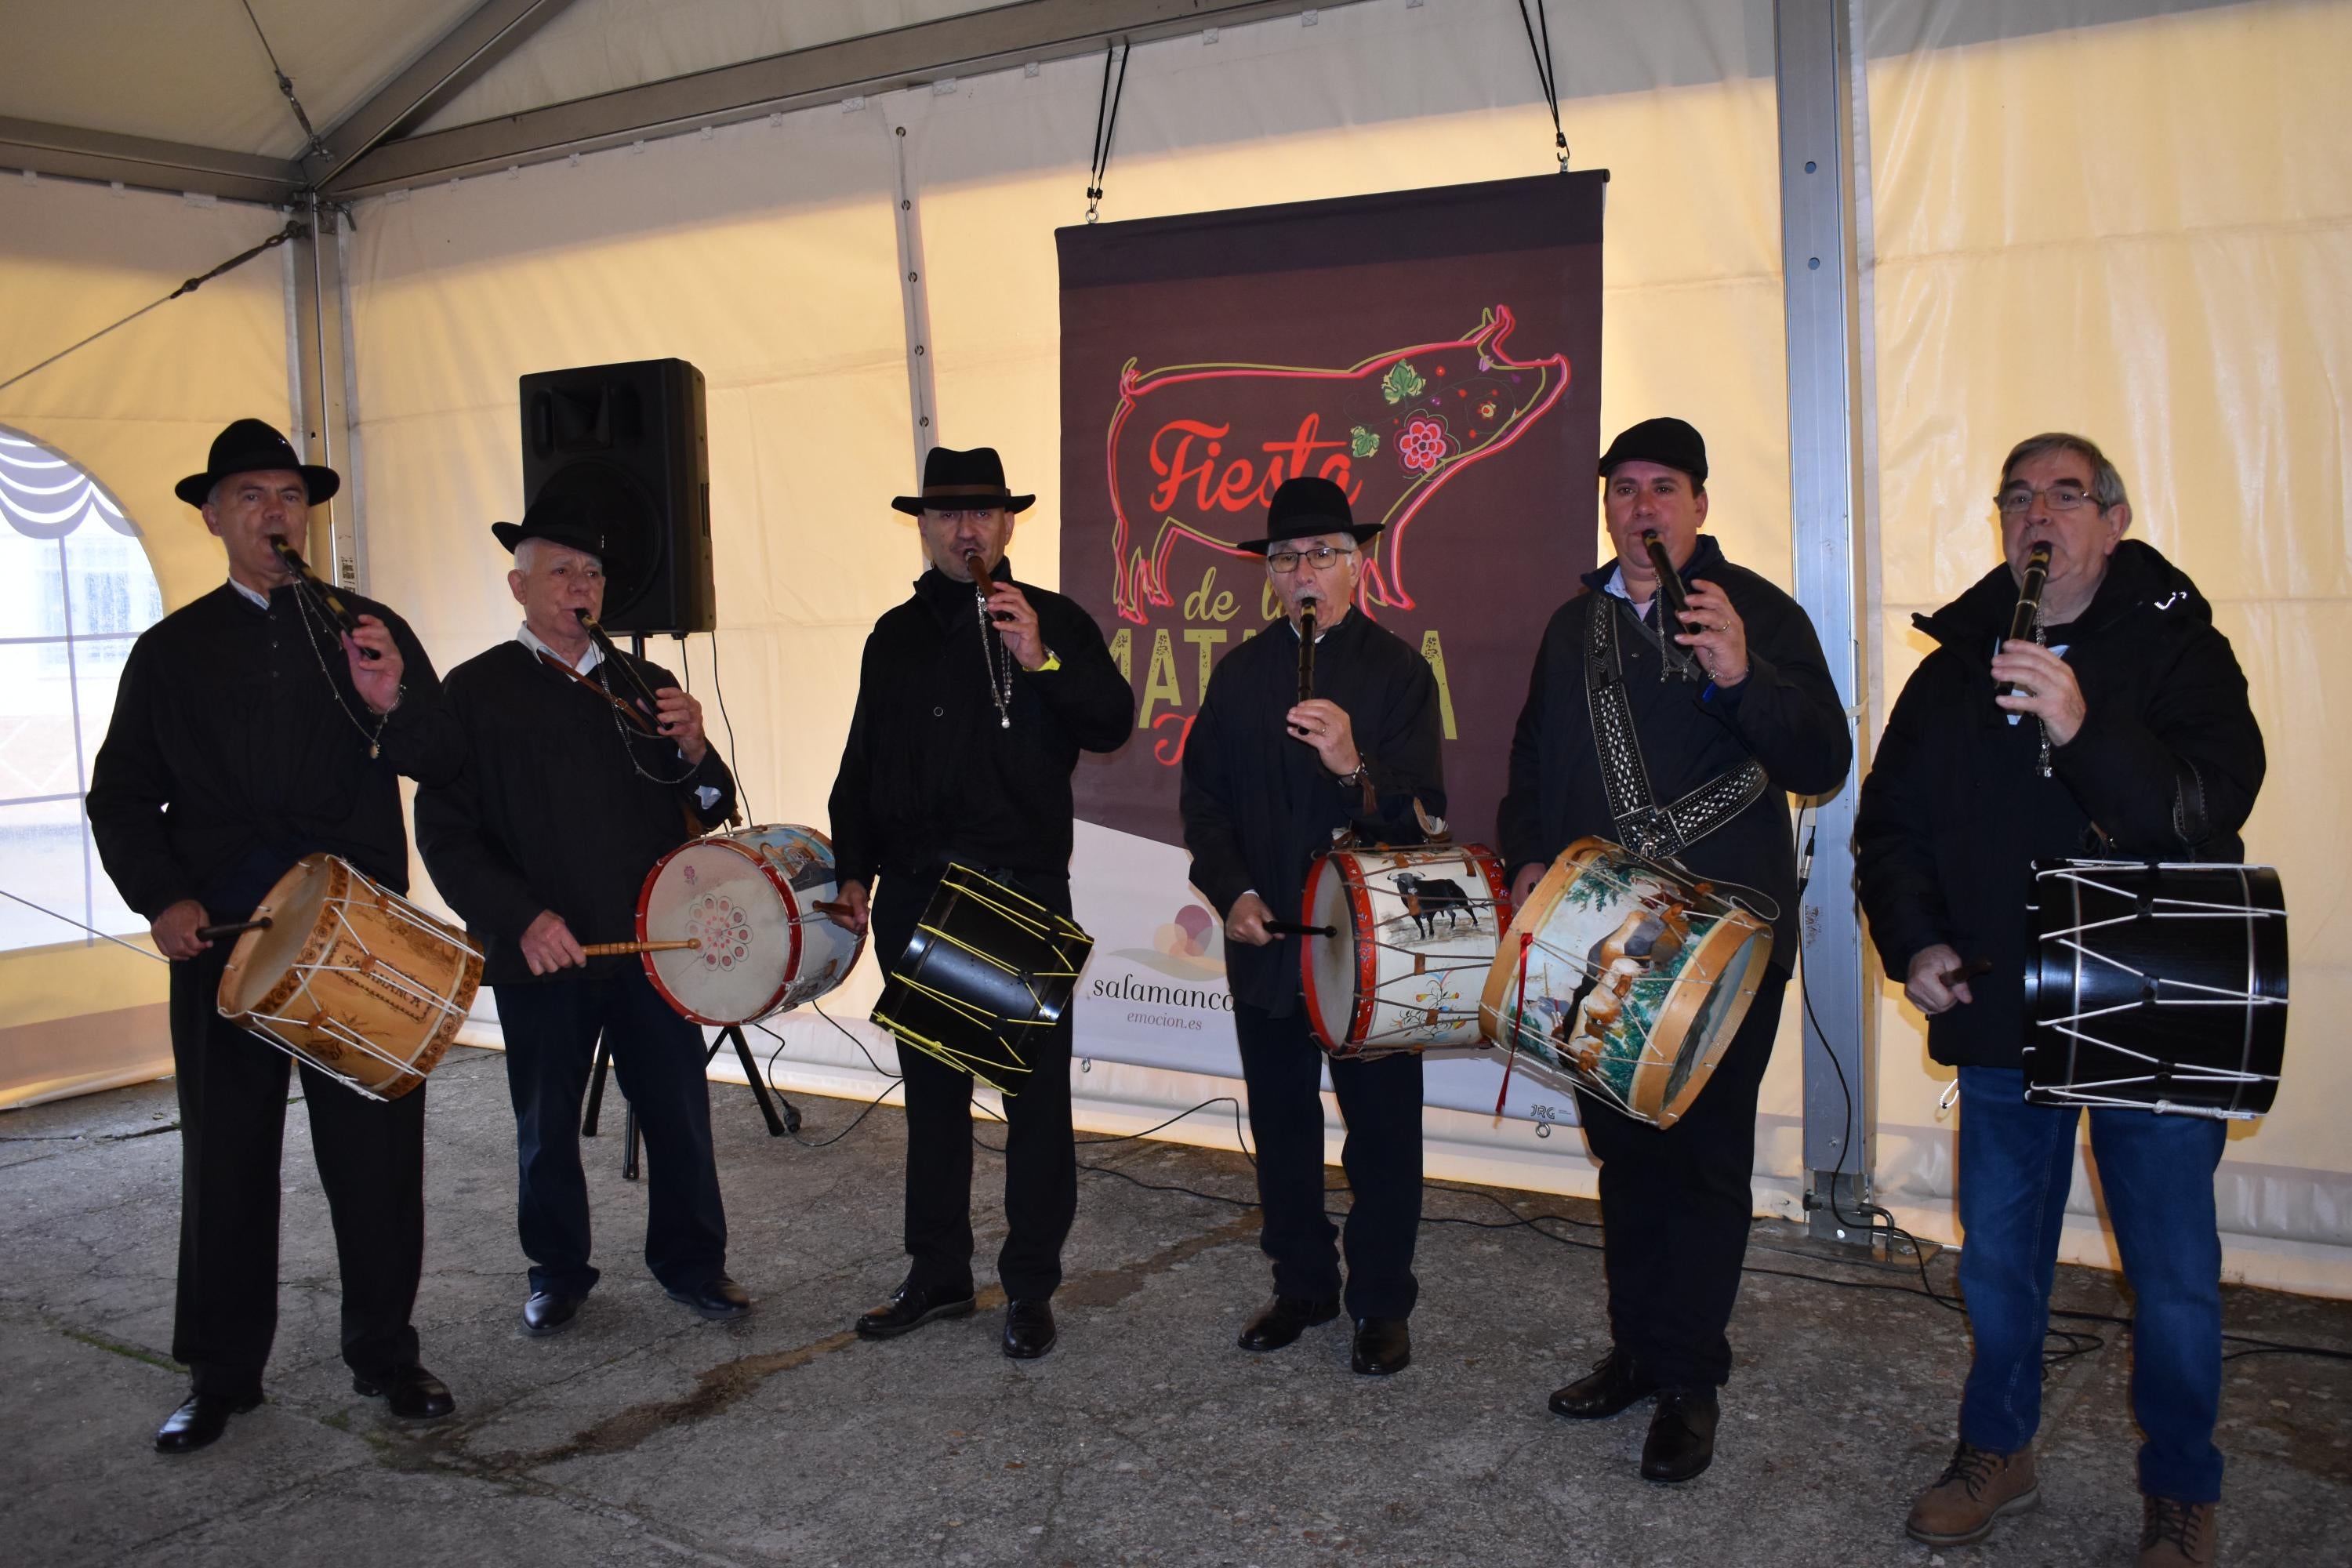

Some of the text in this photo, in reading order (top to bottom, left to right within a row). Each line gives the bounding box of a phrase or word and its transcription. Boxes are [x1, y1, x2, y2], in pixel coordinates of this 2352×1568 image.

[1149, 412, 1363, 512] Fiesta
[1184, 566, 1241, 622] de
[1127, 1011, 1203, 1031] emocion.es
[1530, 1104, 1555, 1120] JRG
